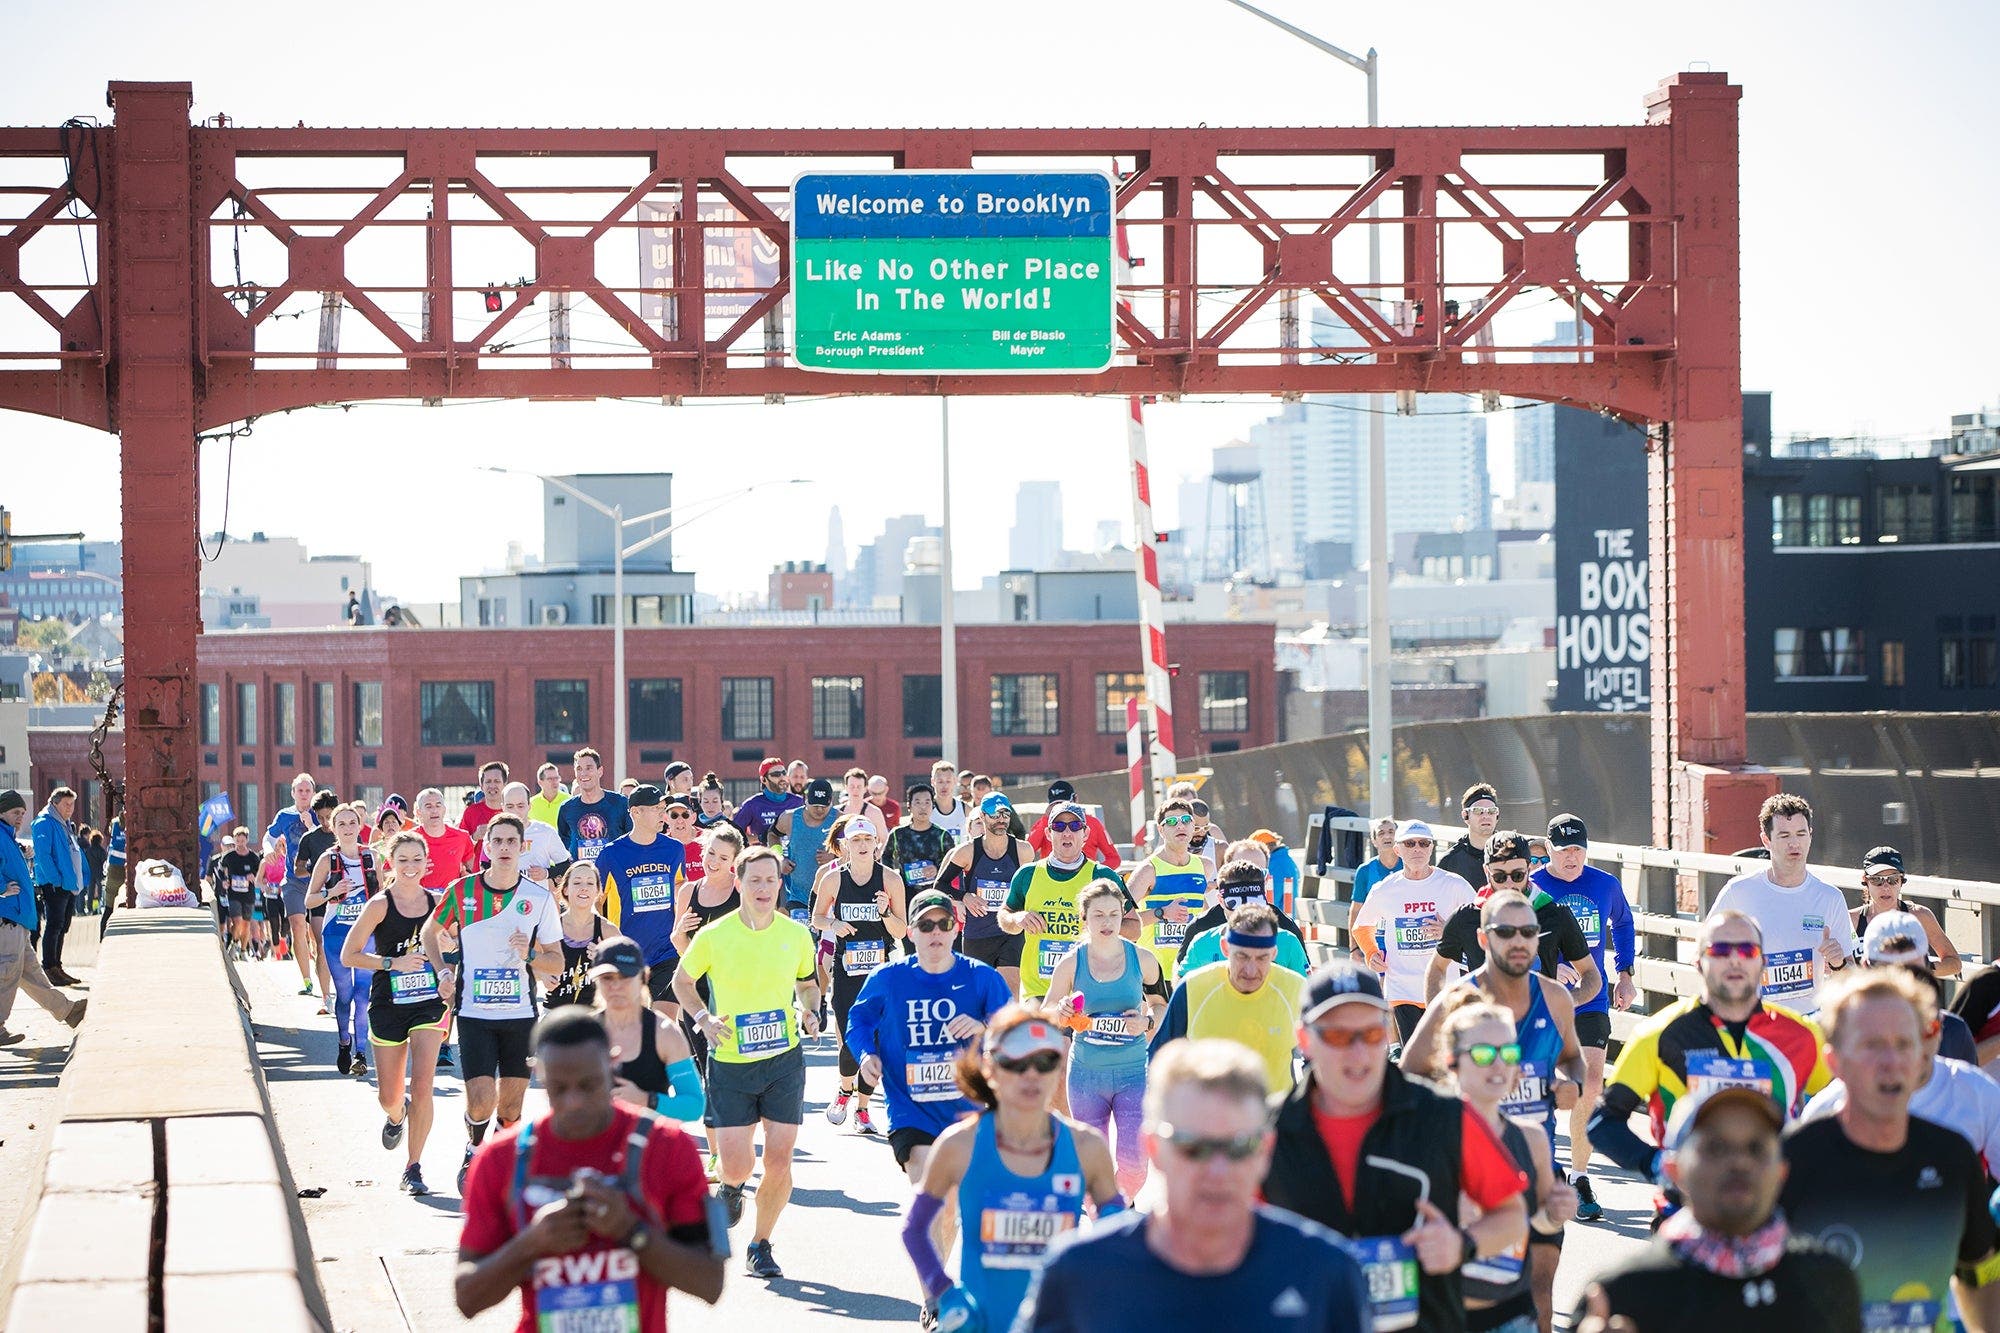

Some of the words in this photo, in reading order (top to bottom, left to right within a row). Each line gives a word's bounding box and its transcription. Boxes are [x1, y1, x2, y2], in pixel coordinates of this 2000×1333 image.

[816, 193, 924, 214] Welcome
[938, 194, 964, 214] to
[976, 193, 1090, 218] Brooklyn
[806, 258, 862, 280] Like
[878, 258, 914, 280] No
[929, 258, 1008, 280] Other
[1025, 258, 1100, 280] Place
[856, 288, 880, 310] In
[896, 288, 946, 310] The
[962, 287, 1052, 310] World!
[834, 331, 856, 342] Eric
[861, 331, 902, 342] Adams
[992, 330, 1011, 340] Bill
[1013, 330, 1028, 340] de
[1030, 330, 1066, 340] Blasio
[816, 346, 864, 358] Borough
[868, 345, 924, 356] President
[1010, 345, 1046, 356] Mayor
[1594, 528, 1634, 558] THE
[1580, 560, 1648, 610] BOX
[1558, 612, 1650, 670] HOUS
[1584, 667, 1650, 704] HOTEL
[626, 864, 671, 878] SWEDEN
[641, 886, 664, 898] 16264
[986, 890, 1005, 900] 11307
[1404, 902, 1436, 914] PPTC
[1048, 924, 1080, 936] KIDS
[1163, 924, 1186, 936] 18747
[1406, 928, 1427, 942] 665
[562, 962, 590, 980] FAST
[1774, 965, 1802, 982] 11544
[484, 981, 512, 994] 17539
[560, 975, 591, 996] FRIEN
[906, 998, 956, 1022] HO
[748, 1024, 778, 1042] 18707
[1096, 1018, 1126, 1033] 13507
[907, 1023, 957, 1046] HA
[920, 1064, 952, 1082] 14122
[1004, 1215, 1054, 1238] 11640
